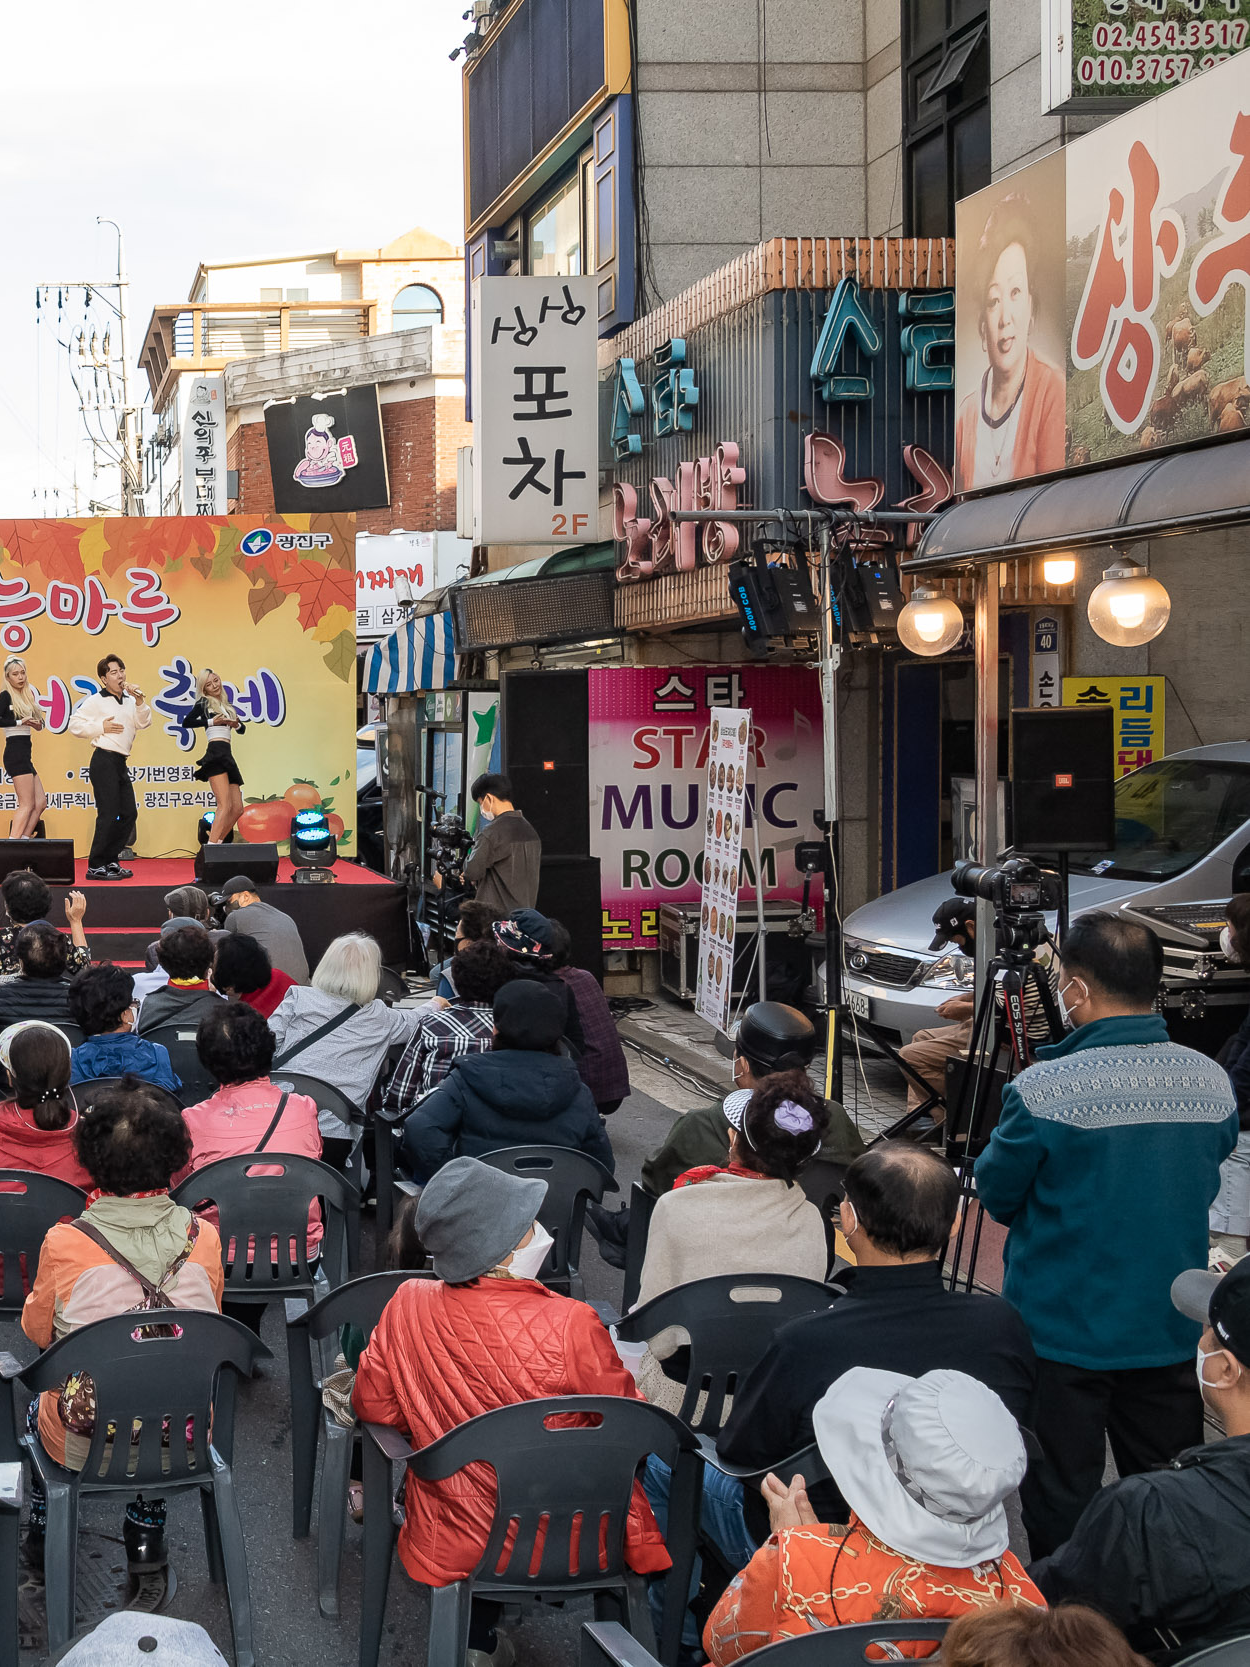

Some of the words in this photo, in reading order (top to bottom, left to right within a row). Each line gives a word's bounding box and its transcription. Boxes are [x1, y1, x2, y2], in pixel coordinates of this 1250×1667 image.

[1096, 23, 1245, 47] 02.454.3517
[551, 513, 589, 536] 2F
[276, 532, 333, 550] 광진구
[1040, 634, 1052, 649] 40
[653, 673, 746, 713] 스타
[600, 782, 799, 831] MUIC
[1010, 994, 1021, 1020] EOS
[1014, 1022, 1023, 1034] 5D
